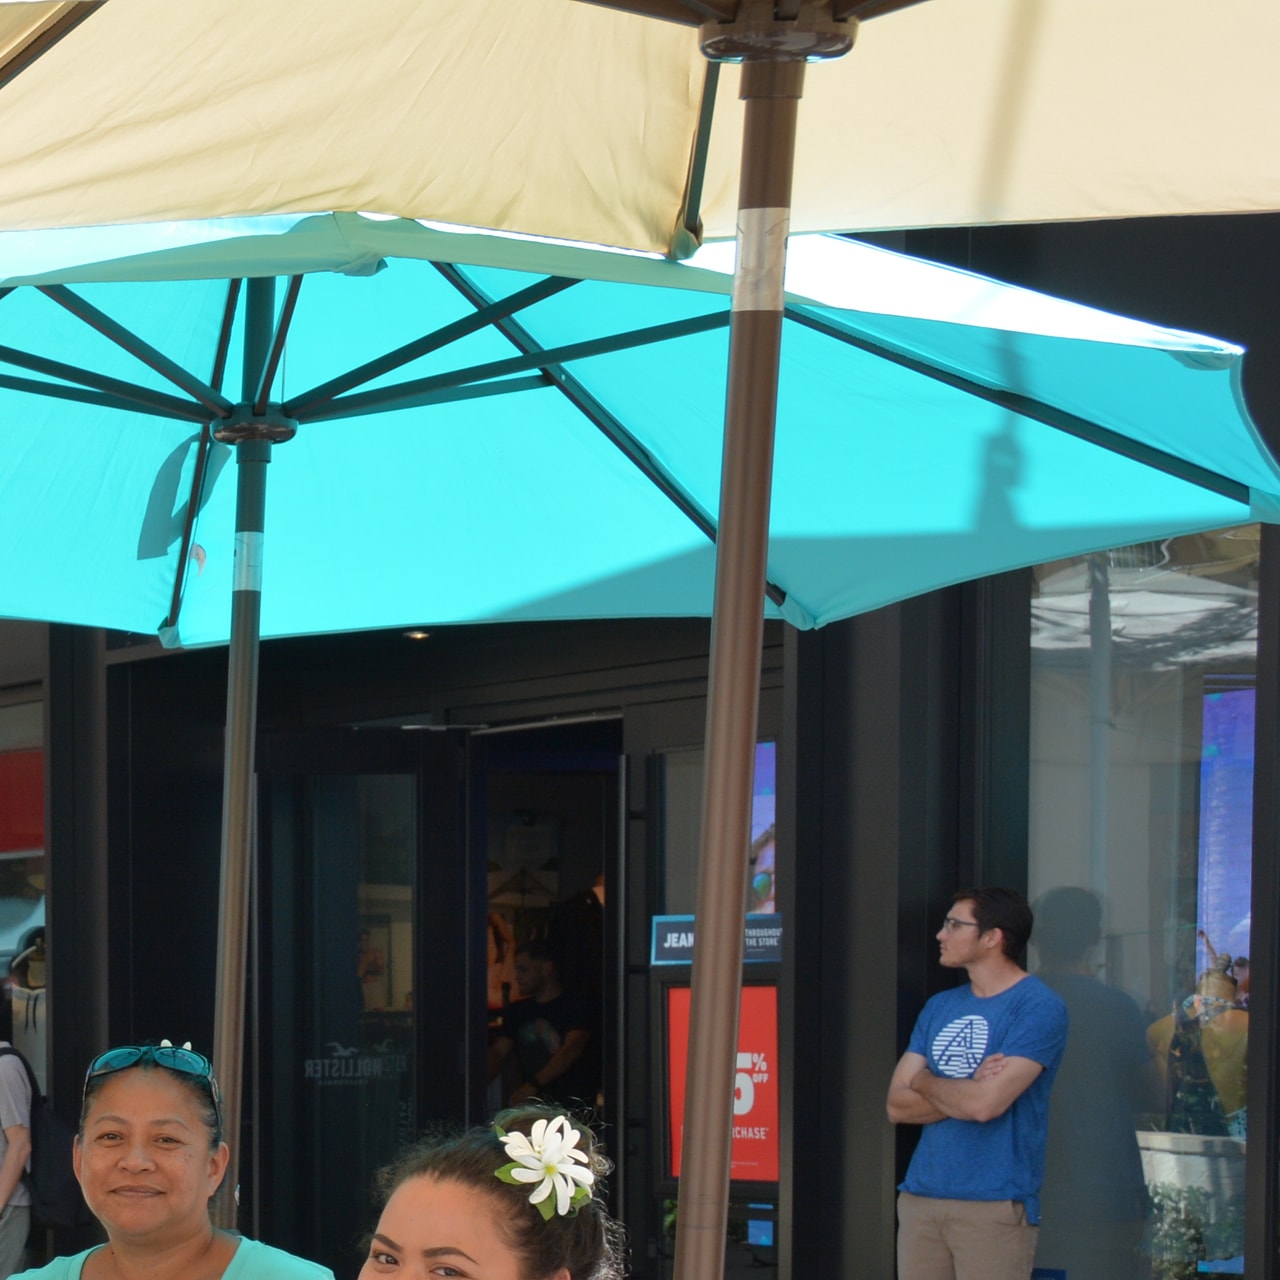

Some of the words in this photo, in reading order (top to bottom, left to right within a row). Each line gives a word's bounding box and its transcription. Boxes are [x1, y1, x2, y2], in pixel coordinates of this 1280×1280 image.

[745, 938, 757, 947] THE
[753, 1073, 769, 1084] OFF
[732, 1126, 768, 1140] RCHASE
